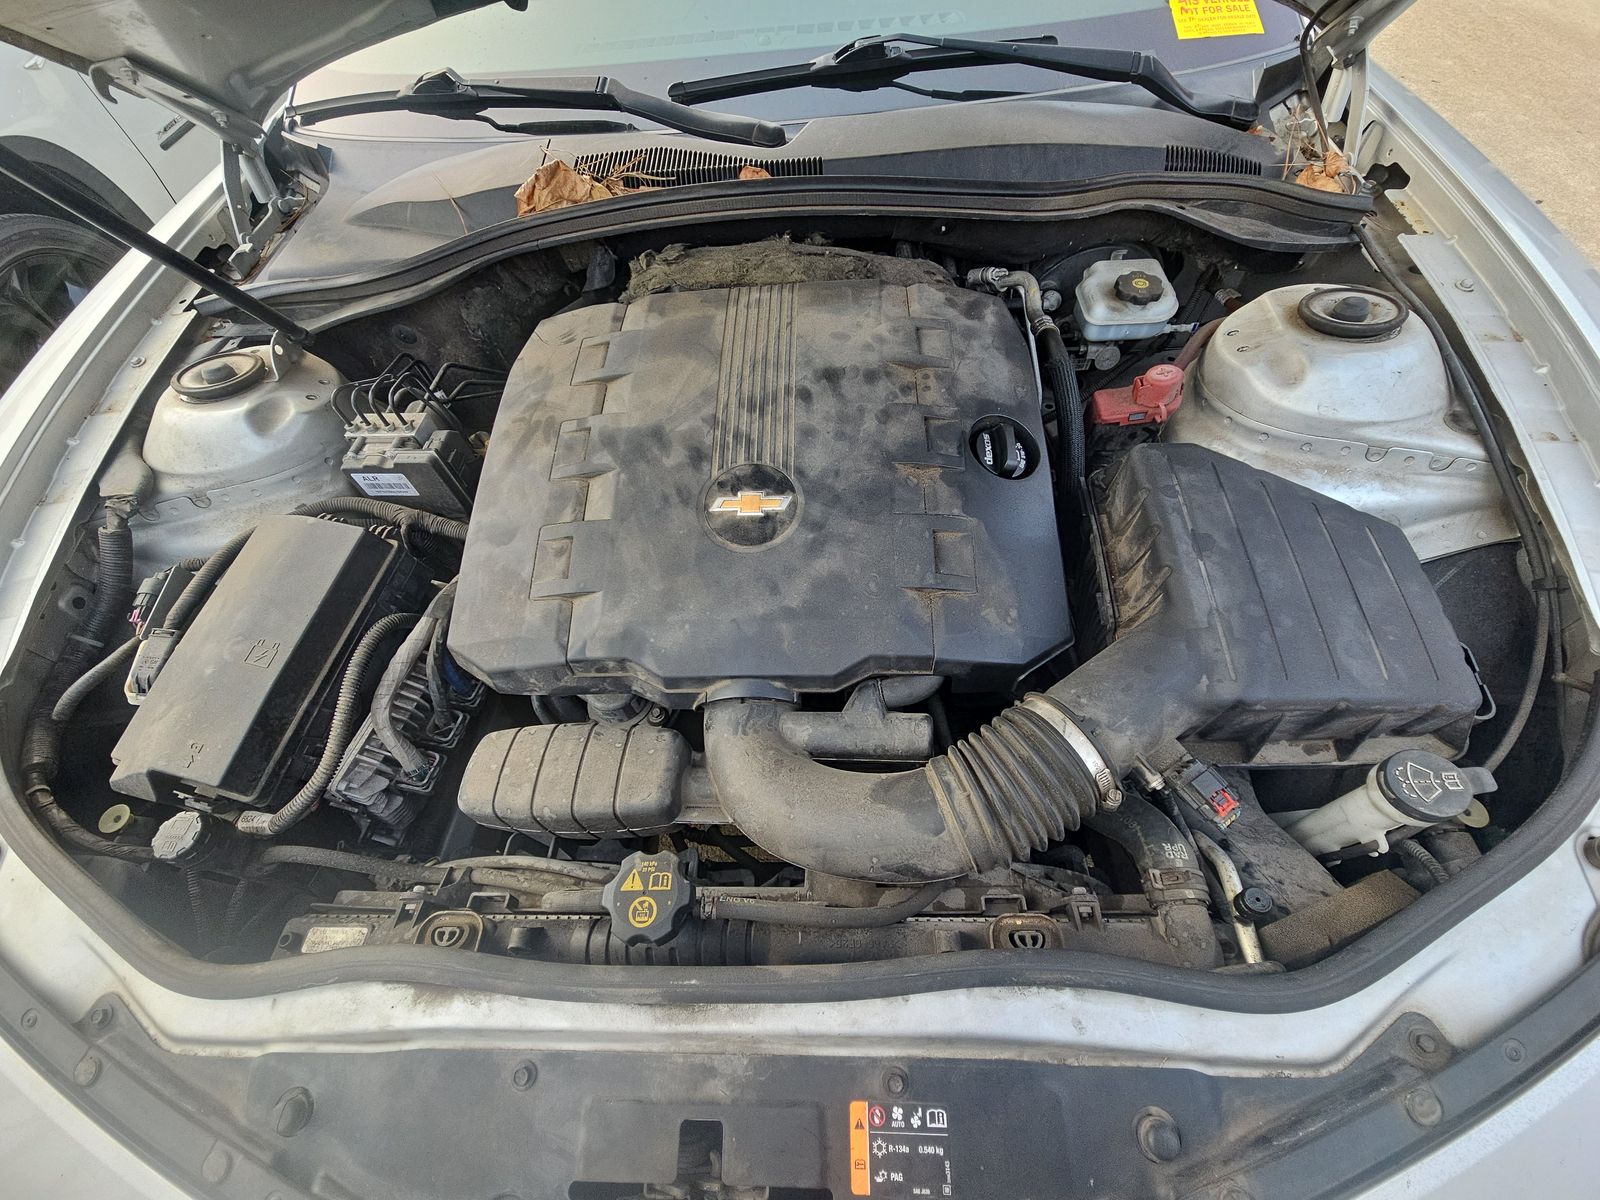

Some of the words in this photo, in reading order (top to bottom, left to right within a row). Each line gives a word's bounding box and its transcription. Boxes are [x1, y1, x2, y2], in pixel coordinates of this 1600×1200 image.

[1202, 5, 1223, 14] FOR
[1225, 4, 1251, 13] SALE
[983, 432, 994, 465] dexos
[1165, 850, 1189, 860] RAD
[891, 1120, 905, 1128] AUTO
[888, 1145, 910, 1153] R-134a
[918, 1145, 935, 1154] 0.540
[935, 1145, 944, 1156] kg
[890, 1172, 903, 1182] PAG
